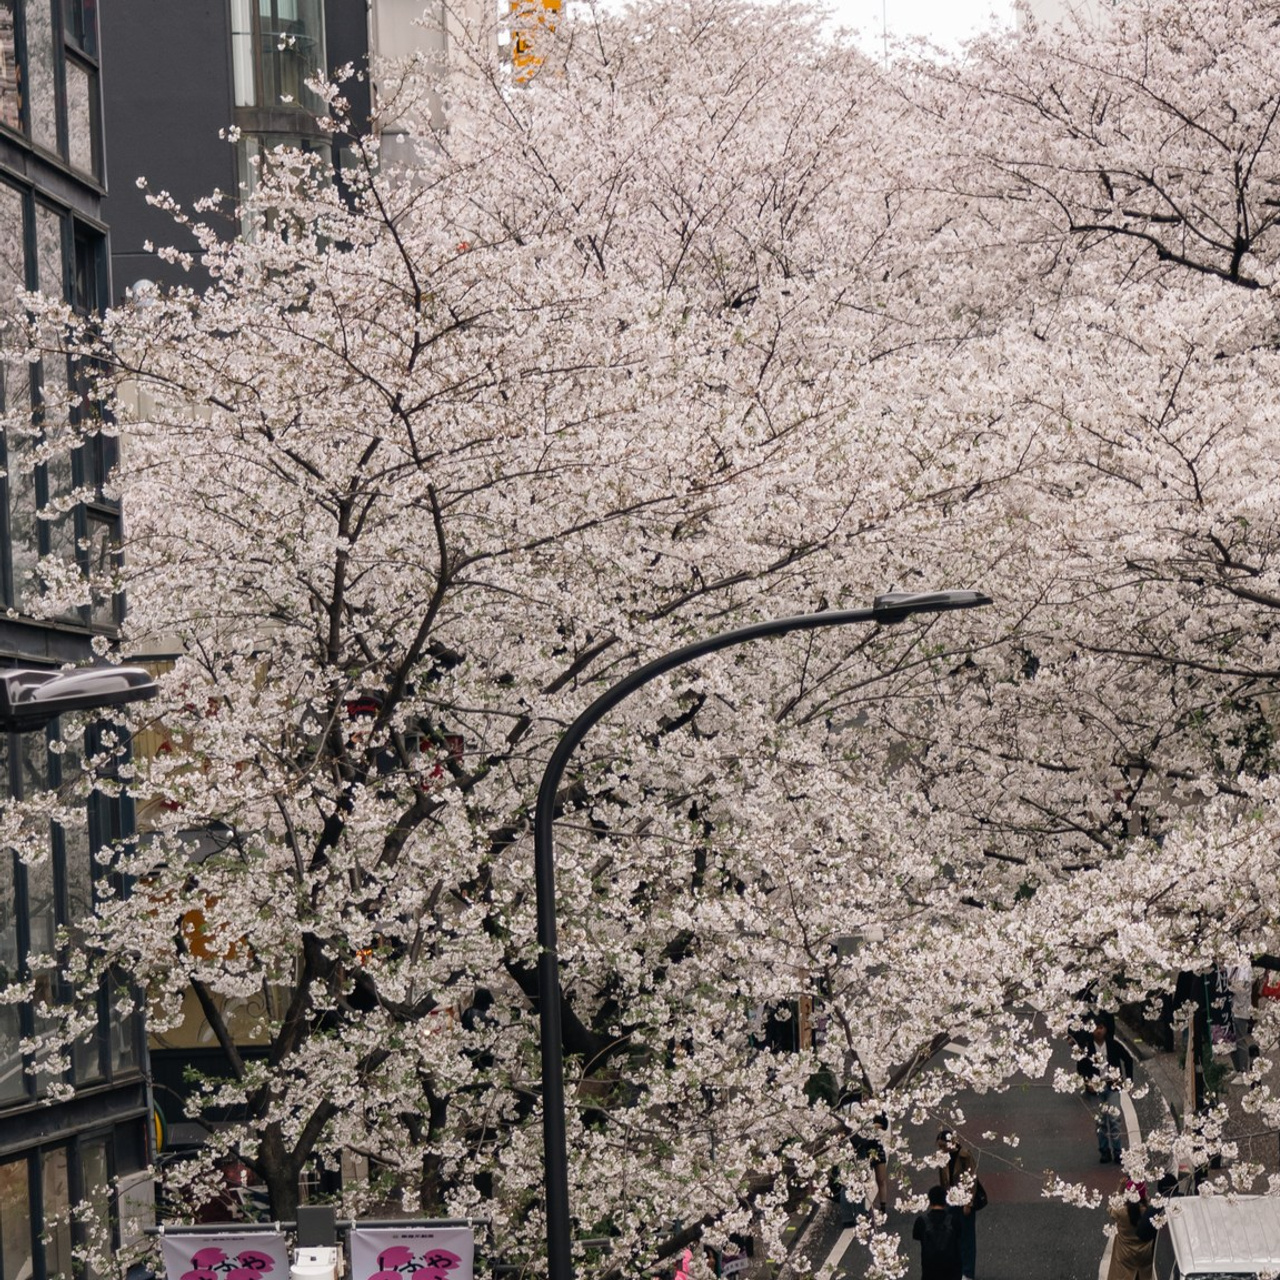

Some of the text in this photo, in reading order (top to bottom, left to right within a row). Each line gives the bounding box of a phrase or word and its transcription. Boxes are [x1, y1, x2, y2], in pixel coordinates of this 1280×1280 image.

[191, 1255, 267, 1273] しぶや
[379, 1254, 453, 1273] しぶや
